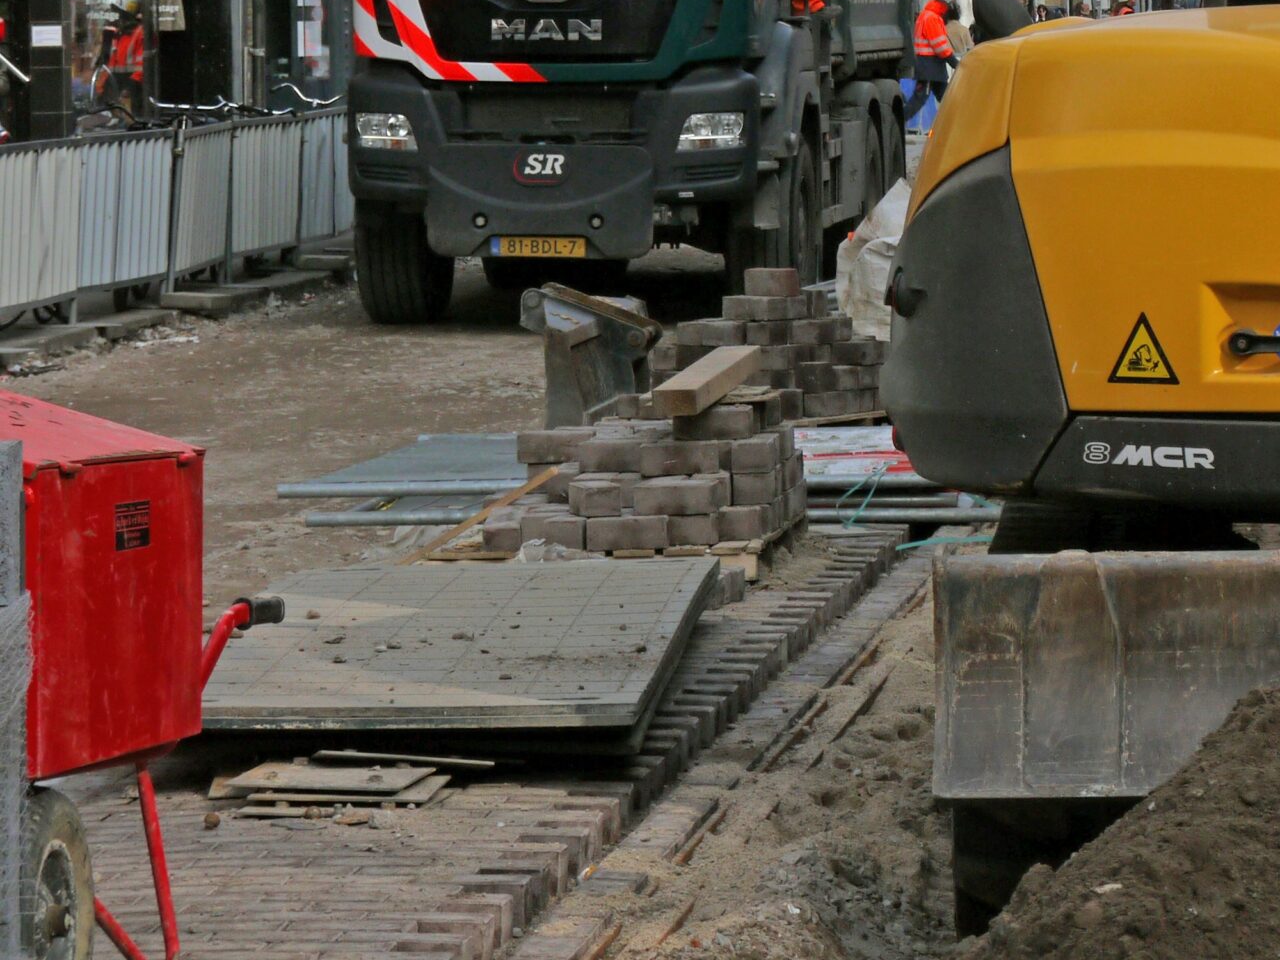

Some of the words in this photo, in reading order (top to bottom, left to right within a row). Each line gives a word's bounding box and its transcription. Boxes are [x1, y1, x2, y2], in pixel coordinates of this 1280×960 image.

[491, 19, 602, 41] MAN
[524, 154, 565, 175] SR
[507, 240, 577, 254] 81-BDL-7
[1083, 442, 1110, 465] 8
[1112, 444, 1215, 469] MCR
